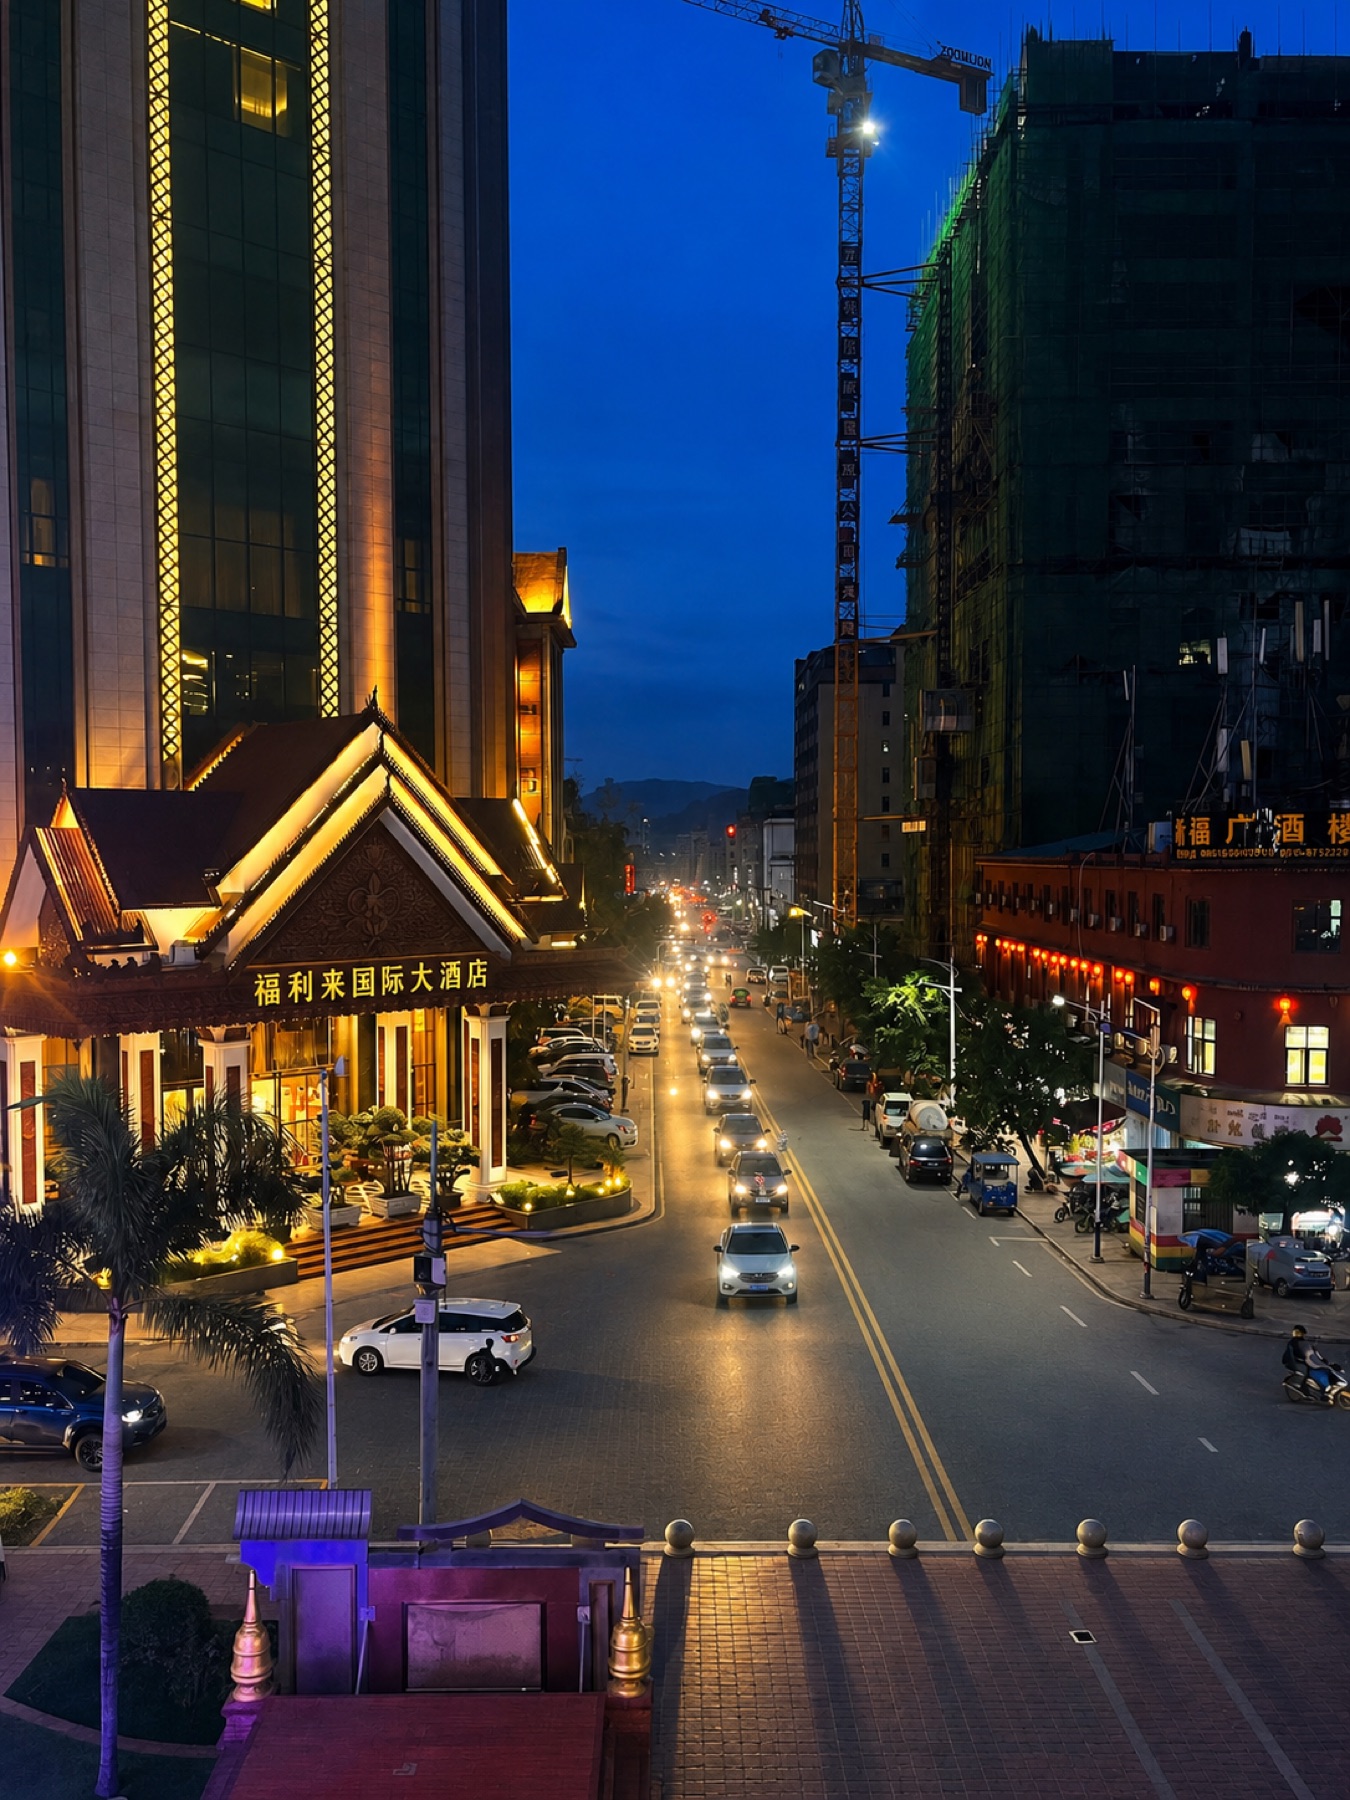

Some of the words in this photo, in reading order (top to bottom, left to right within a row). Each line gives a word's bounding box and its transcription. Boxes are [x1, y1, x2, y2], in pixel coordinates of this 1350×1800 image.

[254, 958, 489, 1007] 福利来国际大酒店
